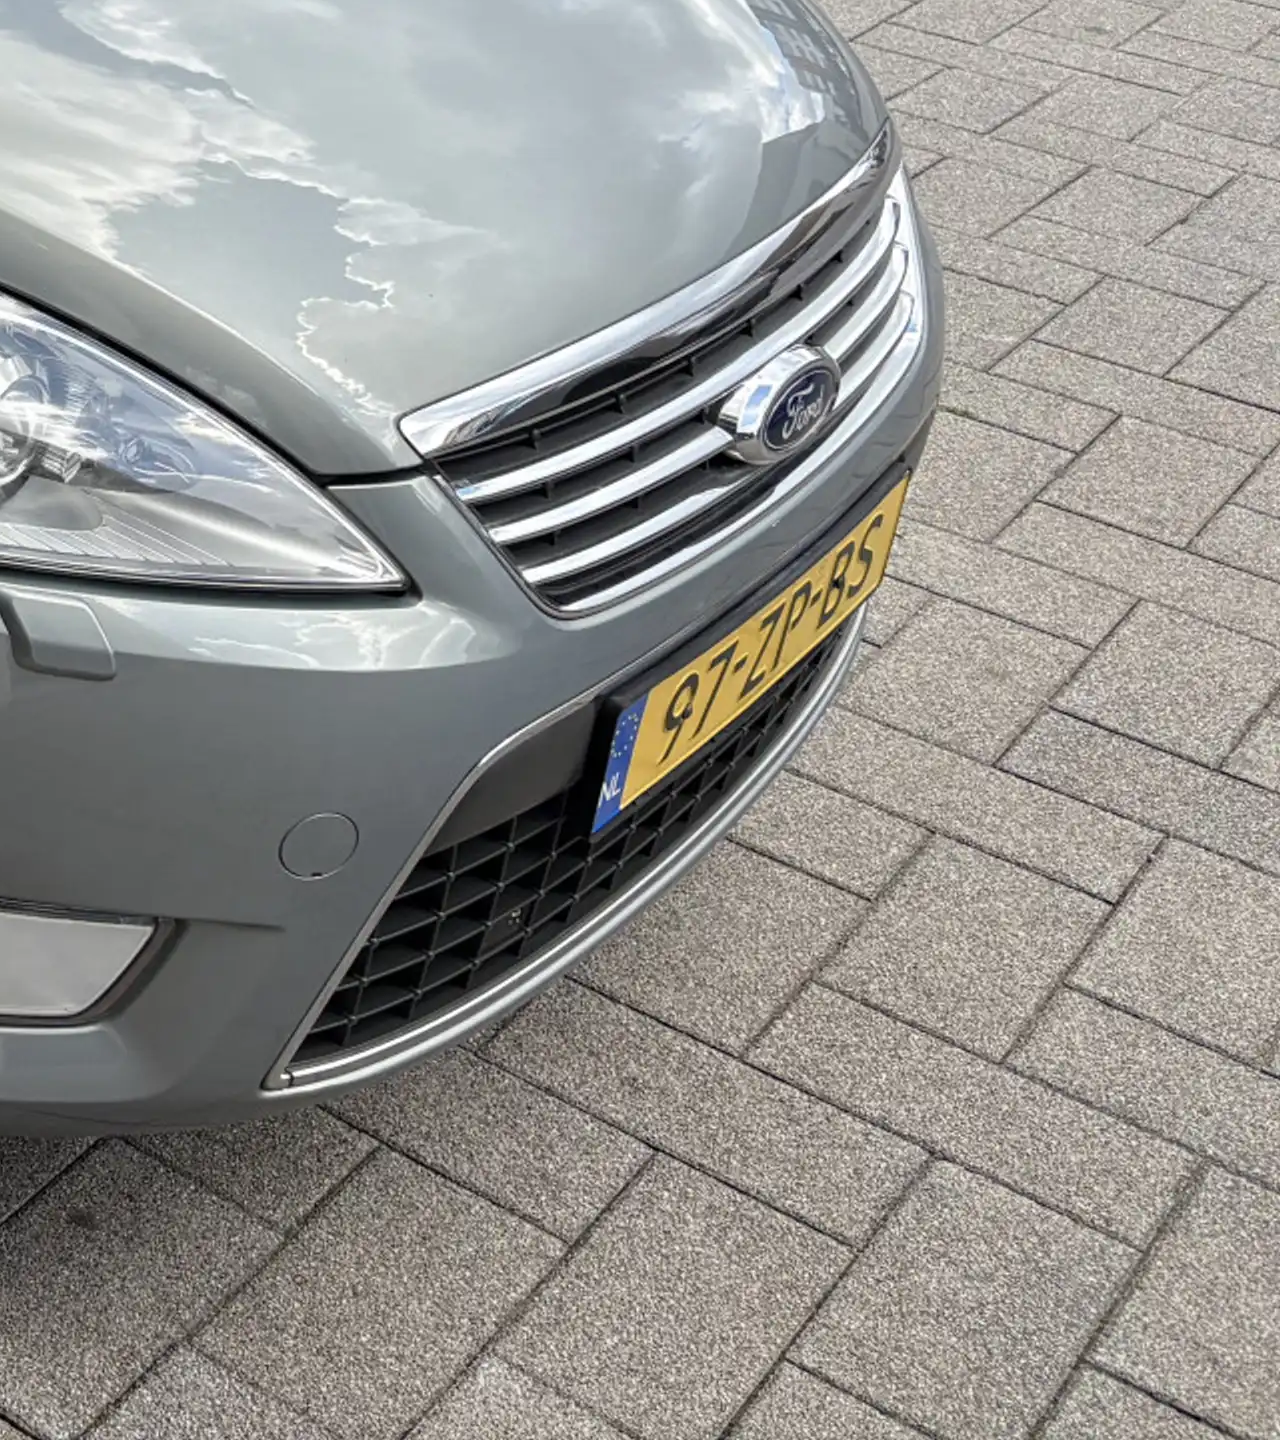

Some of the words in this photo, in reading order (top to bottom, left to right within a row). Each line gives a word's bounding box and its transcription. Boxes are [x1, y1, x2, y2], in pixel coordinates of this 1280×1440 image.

[781, 382, 826, 440] Ford
[656, 512, 886, 766] 97-ZP-BS
[598, 771, 621, 809] NL
